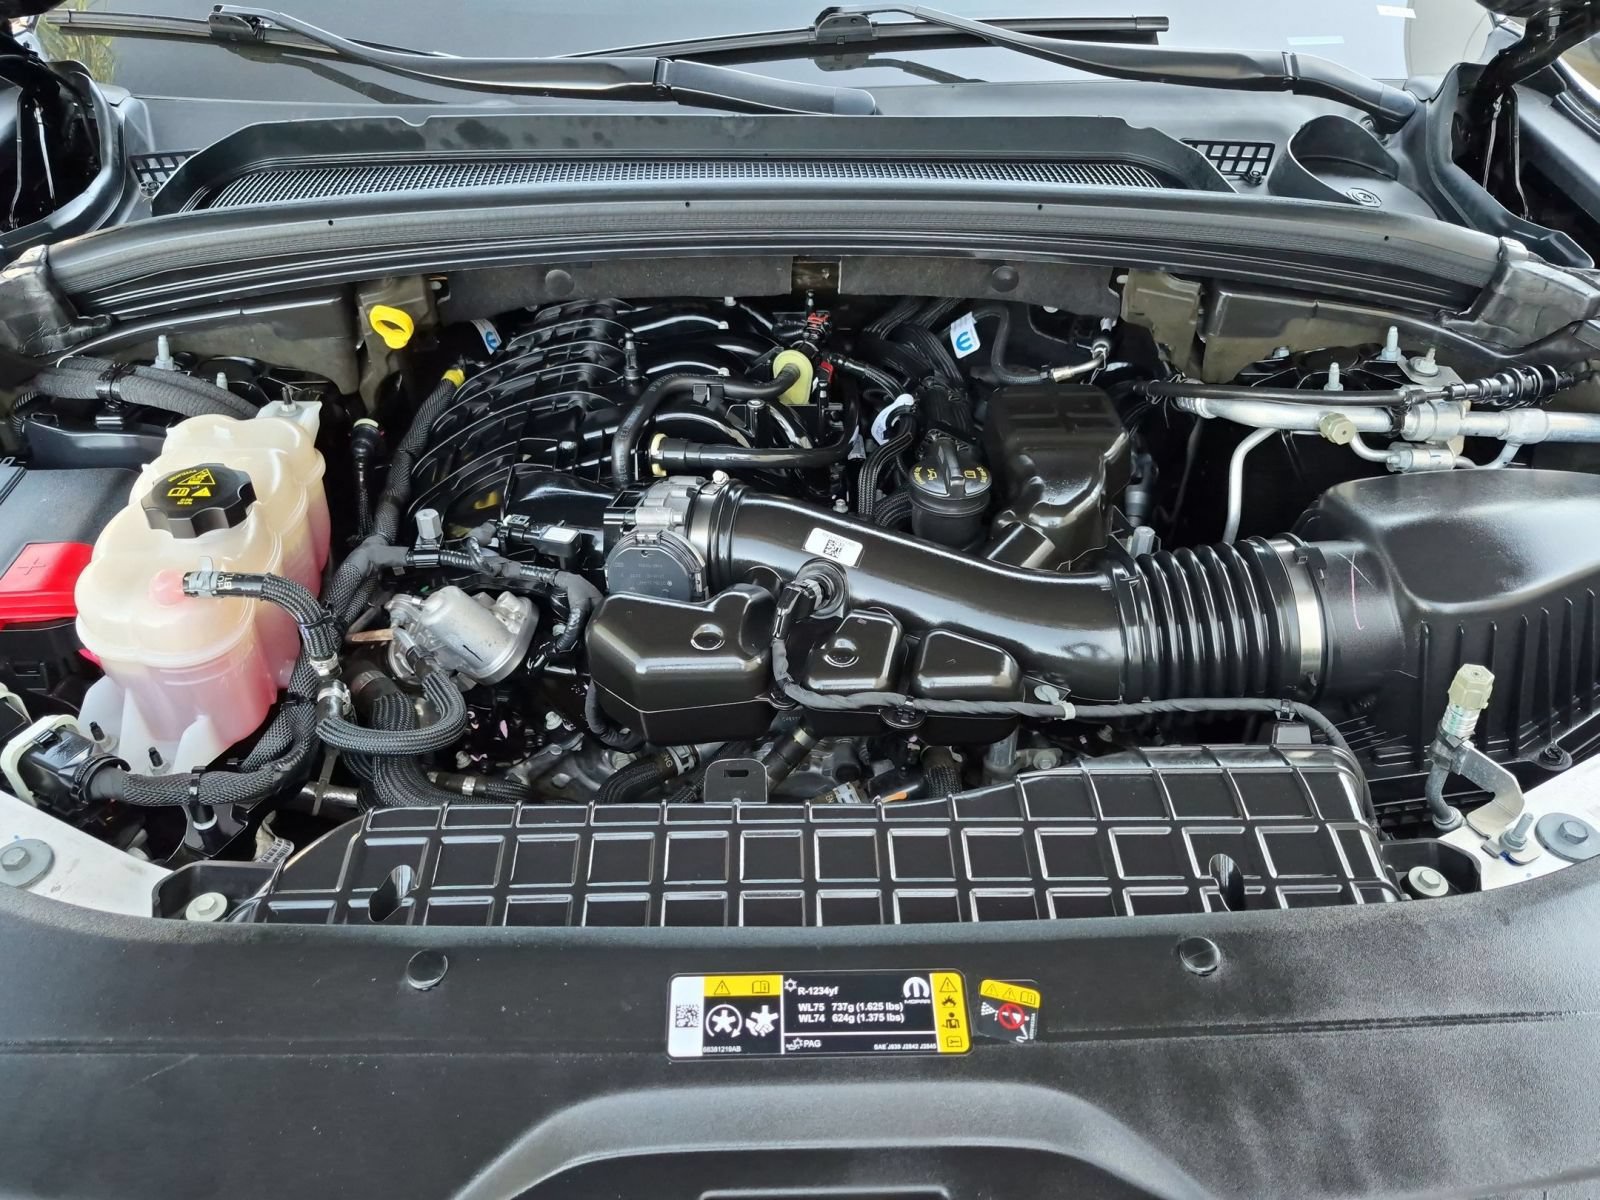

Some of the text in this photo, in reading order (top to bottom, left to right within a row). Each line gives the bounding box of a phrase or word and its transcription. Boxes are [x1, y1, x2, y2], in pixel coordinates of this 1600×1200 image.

[797, 986, 839, 997] R-1234yf
[798, 1002, 904, 1013] WL75 737g (1.625 lbs)
[798, 1013, 905, 1024] WL74 624g (1.375 lbs)
[803, 1039, 822, 1048] PAG
